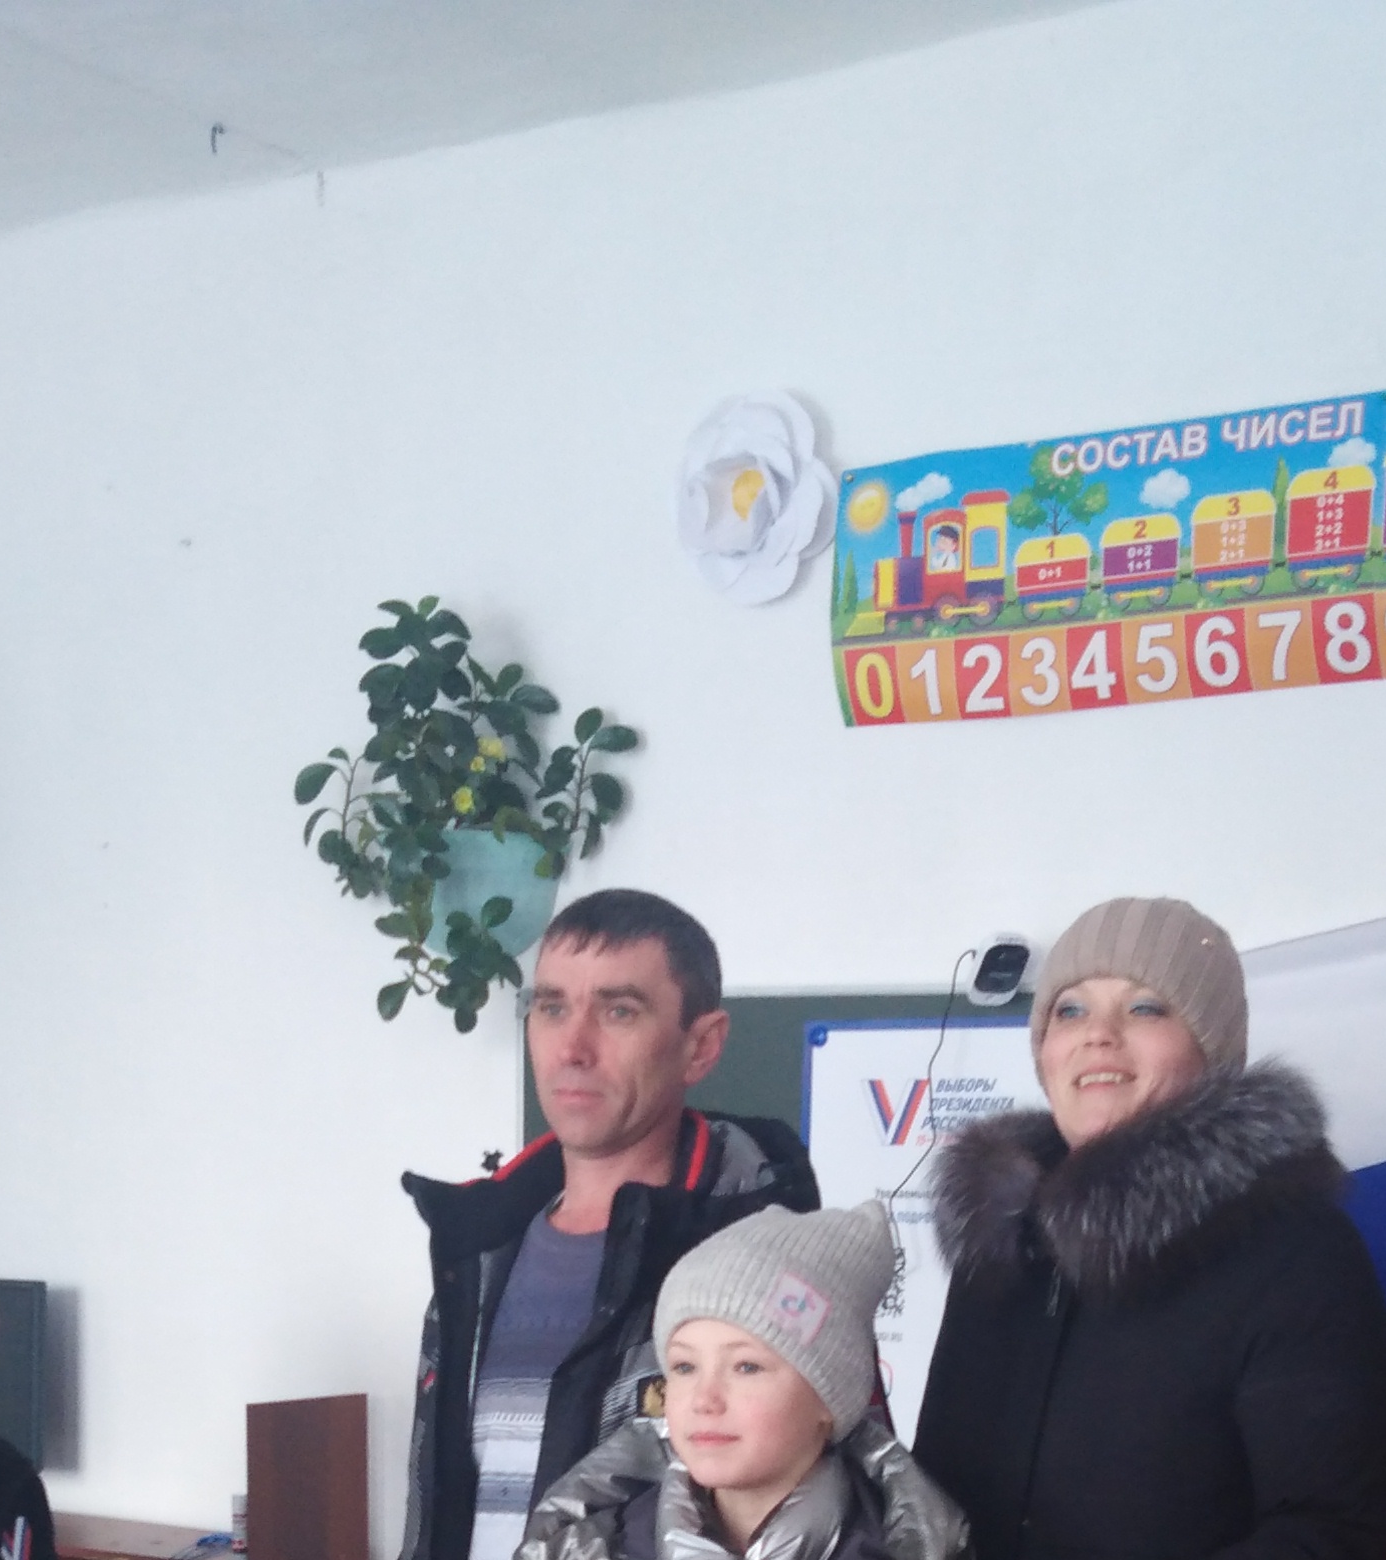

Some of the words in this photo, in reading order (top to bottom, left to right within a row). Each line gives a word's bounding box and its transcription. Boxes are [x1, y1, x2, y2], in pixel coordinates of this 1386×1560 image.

[1050, 421, 1209, 478] СОСТАВ
[1222, 402, 1364, 452] ЧИСЕЛ
[1324, 471, 1339, 490] 4
[1227, 497, 1240, 516] 3
[1134, 520, 1148, 539] 2
[1315, 523, 1343, 537] 2+2
[1045, 541, 1056, 558] 1
[1127, 543, 1153, 558] 0+2
[1038, 567, 1062, 580] 0+1
[1128, 558, 1152, 573] 1+1
[854, 652, 897, 718] 0
[910, 650, 944, 717] 1
[963, 643, 1005, 714] 2
[1021, 638, 1061, 709] 3
[1068, 631, 1116, 701] 4
[1135, 623, 1180, 694] 5
[1193, 616, 1241, 689] 6
[1257, 611, 1303, 682] 7
[1324, 604, 1372, 674] 8
[935, 1078, 998, 1093] ВЫБОРЫ
[929, 1097, 1015, 1113] ПРЕЗИДЕНТА
